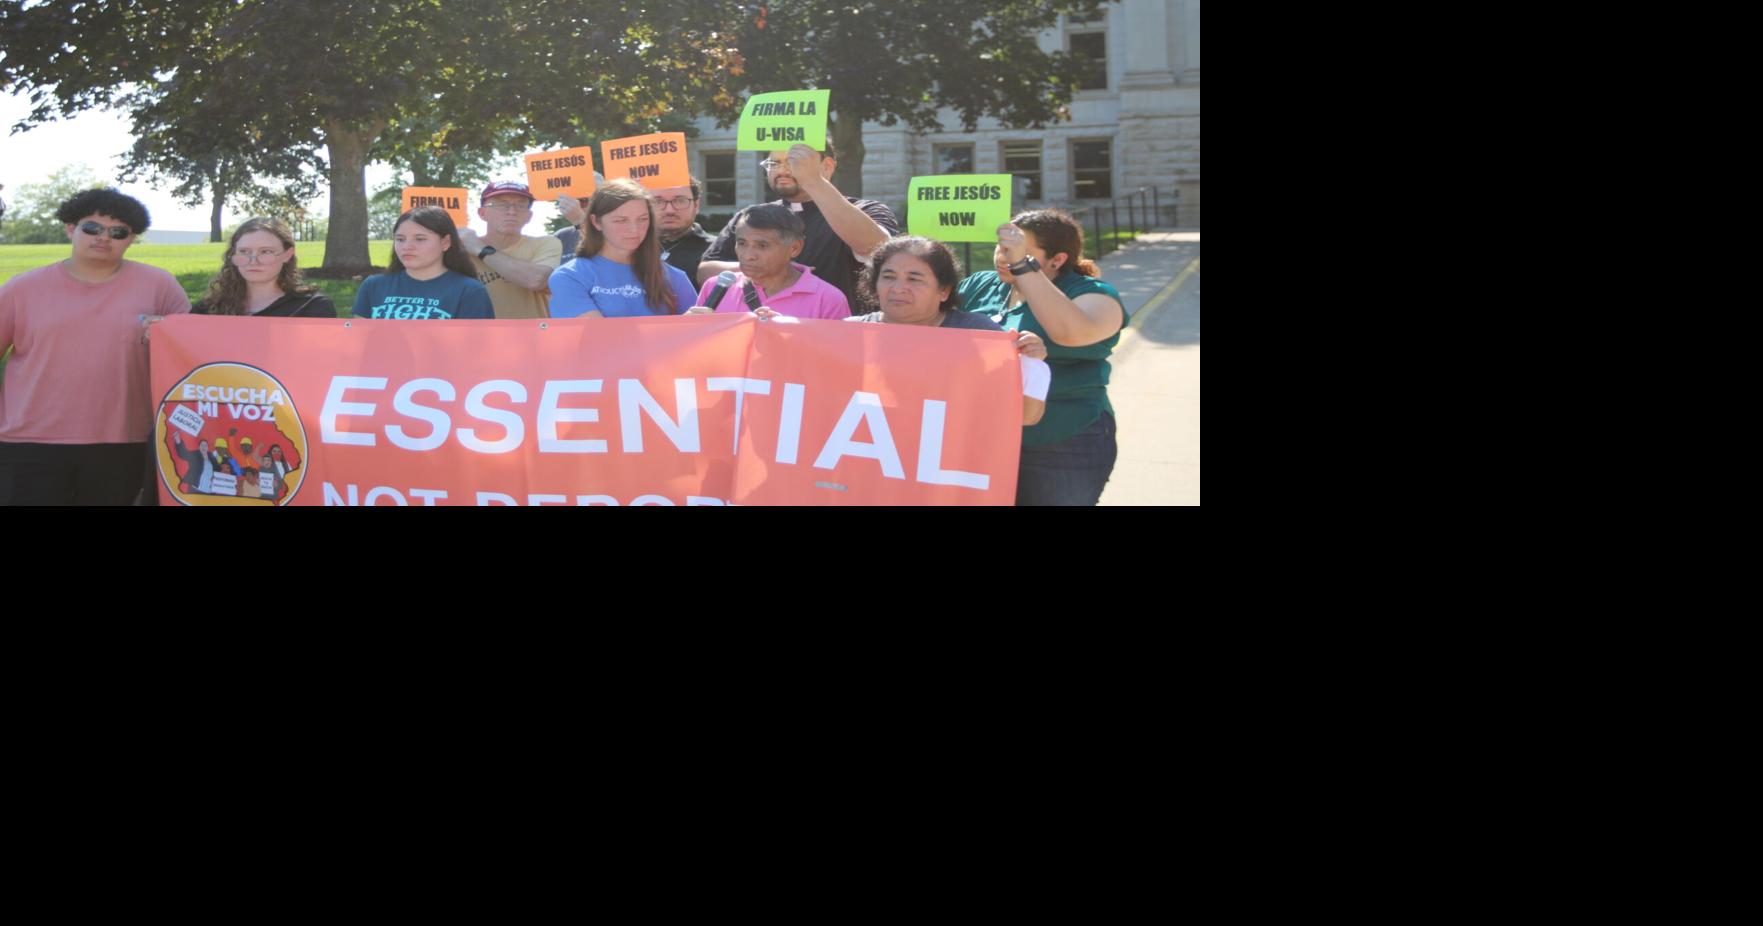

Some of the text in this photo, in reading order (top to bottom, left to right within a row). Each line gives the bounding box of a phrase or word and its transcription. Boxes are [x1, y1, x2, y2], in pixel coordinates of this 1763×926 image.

[751, 101, 817, 116] FIRMA LA
[756, 127, 805, 142] U-VISA
[610, 139, 678, 161] FREE JESÚS
[531, 154, 586, 172] FREE JESÚS
[629, 163, 660, 179] NOW
[546, 176, 572, 190] NOW
[917, 182, 1001, 201] FREE JESÚS
[410, 195, 460, 210] FIRMA LA
[938, 211, 976, 227] NOW
[384, 296, 440, 306] BETTER TO
[371, 303, 453, 320] FIGHT
[182, 383, 285, 406] ESCUCHA
[197, 401, 276, 422] MI VOZ
[319, 374, 991, 491] ESSENTIAL
